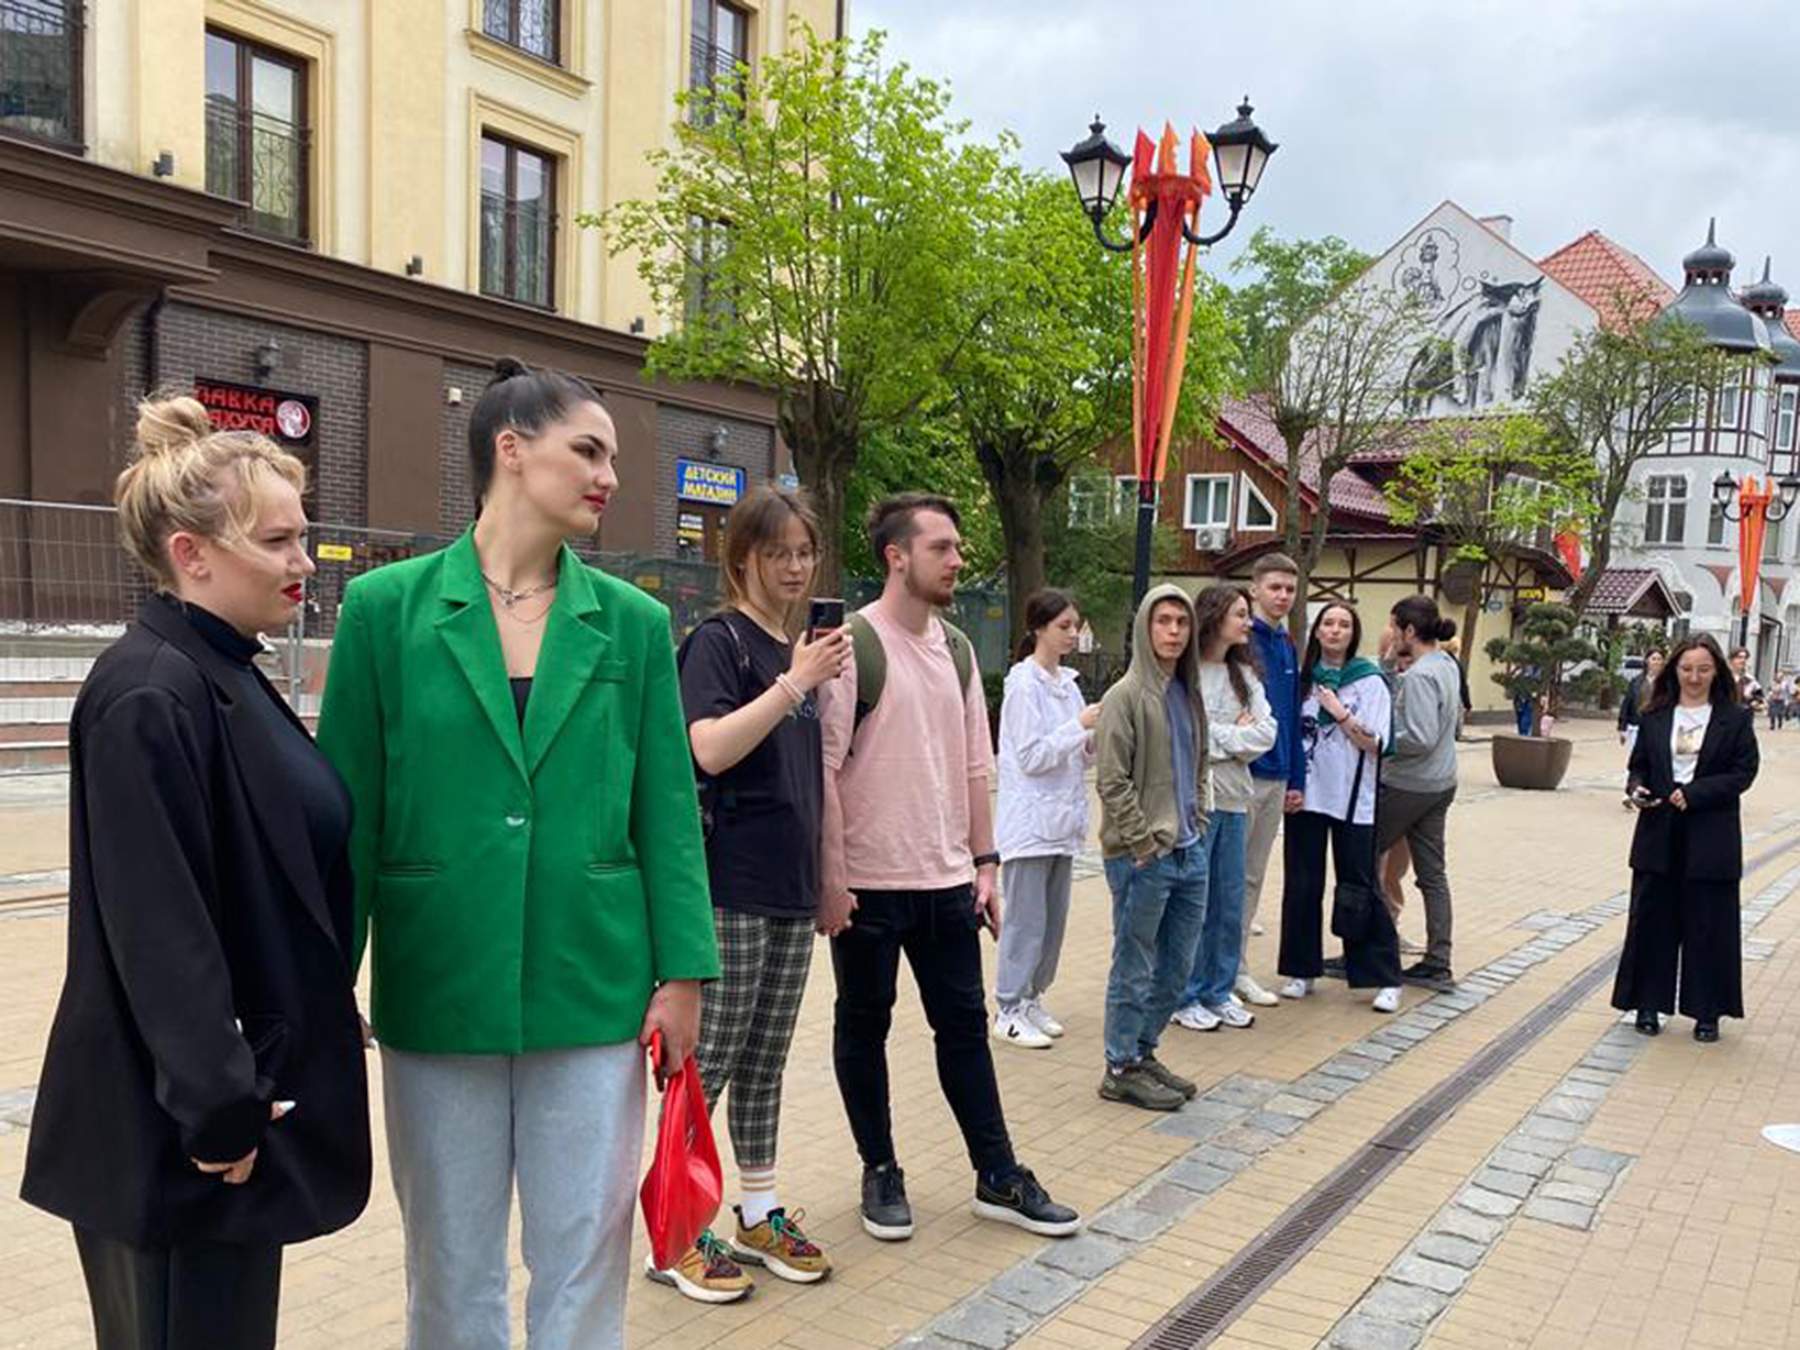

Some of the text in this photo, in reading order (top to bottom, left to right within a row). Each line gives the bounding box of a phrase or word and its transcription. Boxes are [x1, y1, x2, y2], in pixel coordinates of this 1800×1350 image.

[206, 410, 276, 435] АХУСА
[685, 465, 737, 485] ДЕТСКИЙ
[683, 482, 737, 501] МАГАЗИН
